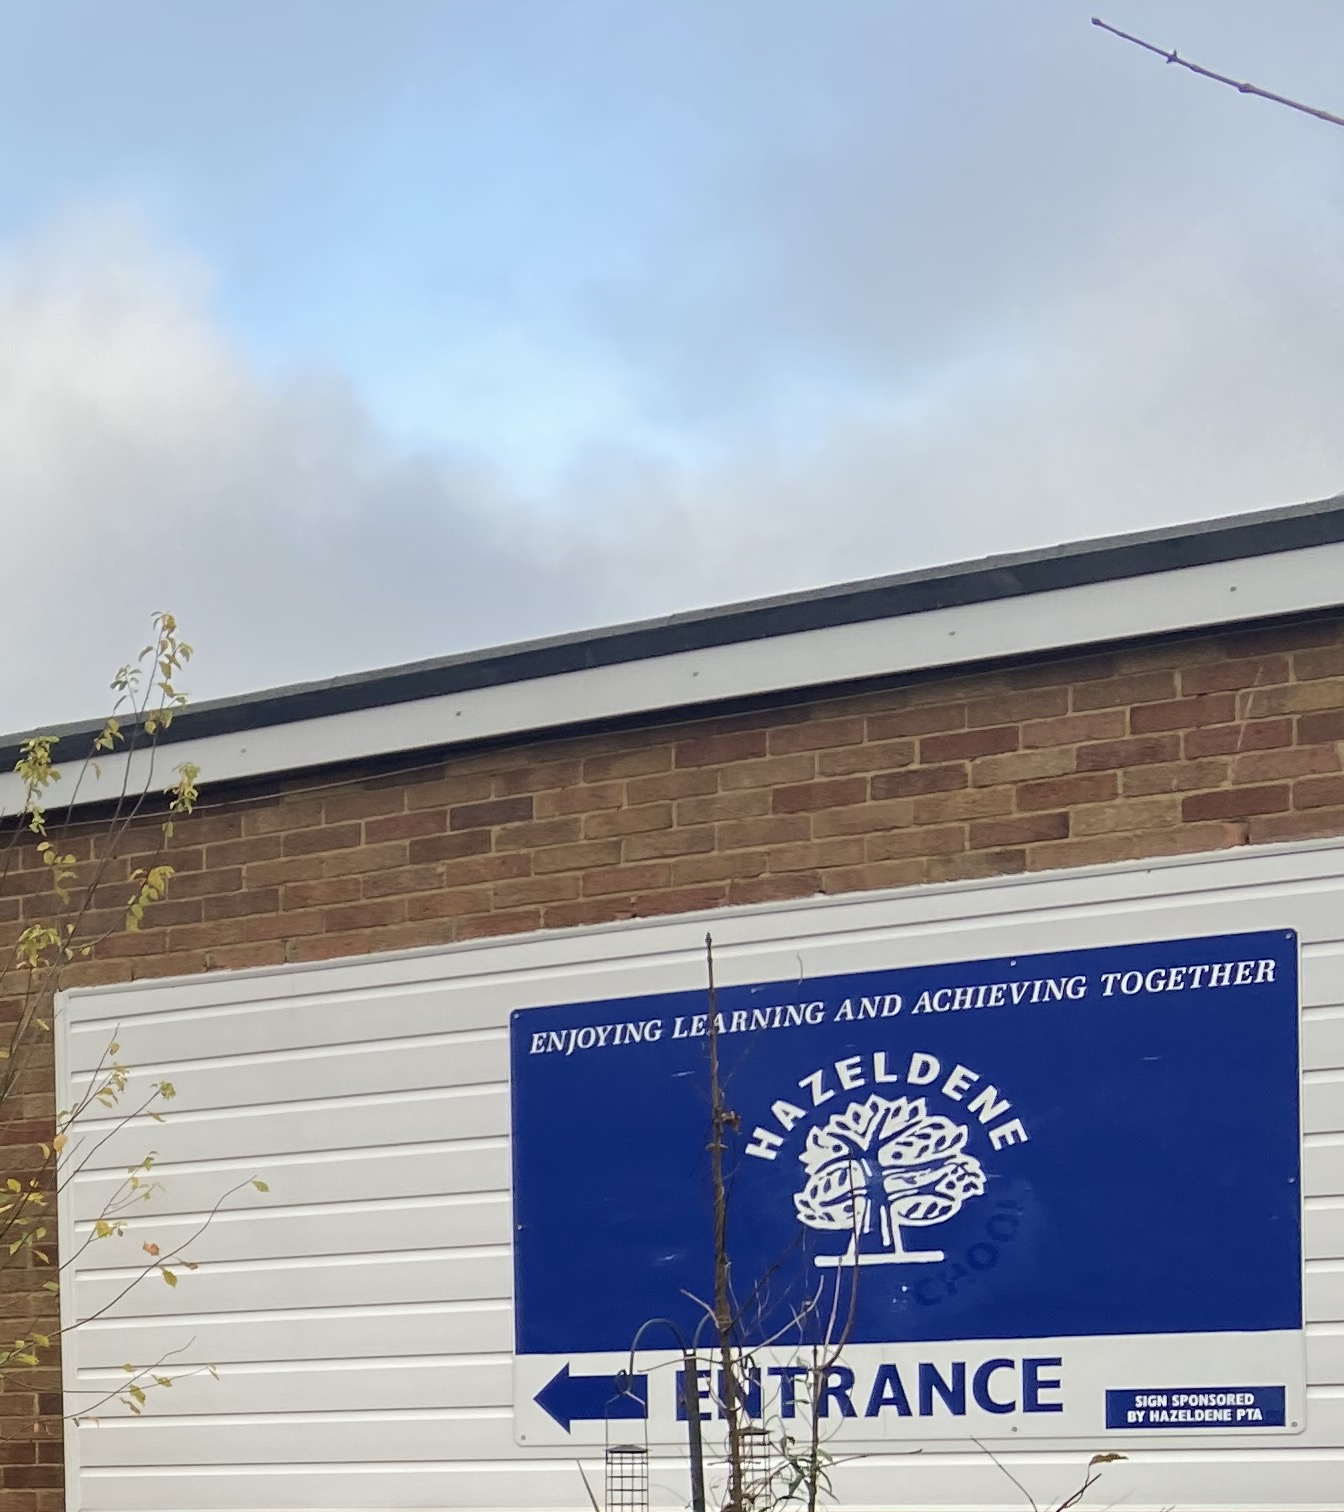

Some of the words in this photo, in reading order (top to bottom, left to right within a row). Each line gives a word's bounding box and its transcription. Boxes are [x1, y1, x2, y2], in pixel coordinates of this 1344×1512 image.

[529, 1019, 663, 1056] ENJOYING
[672, 1001, 825, 1040] LEARNING
[834, 993, 903, 1022] AND
[911, 975, 1087, 1015] ACHIEVING
[1100, 958, 1277, 997] TOGETHER
[744, 1051, 1029, 1161] HAZELDENE
[675, 1356, 1064, 1422] ENTRANCE
[1127, 1410, 1146, 1423] BY
[1149, 1409, 1232, 1422] HAZELDENE
[1236, 1408, 1263, 1421] PTA
[1135, 1395, 1168, 1408] SIGN
[1172, 1393, 1255, 1407] SPONSORED
